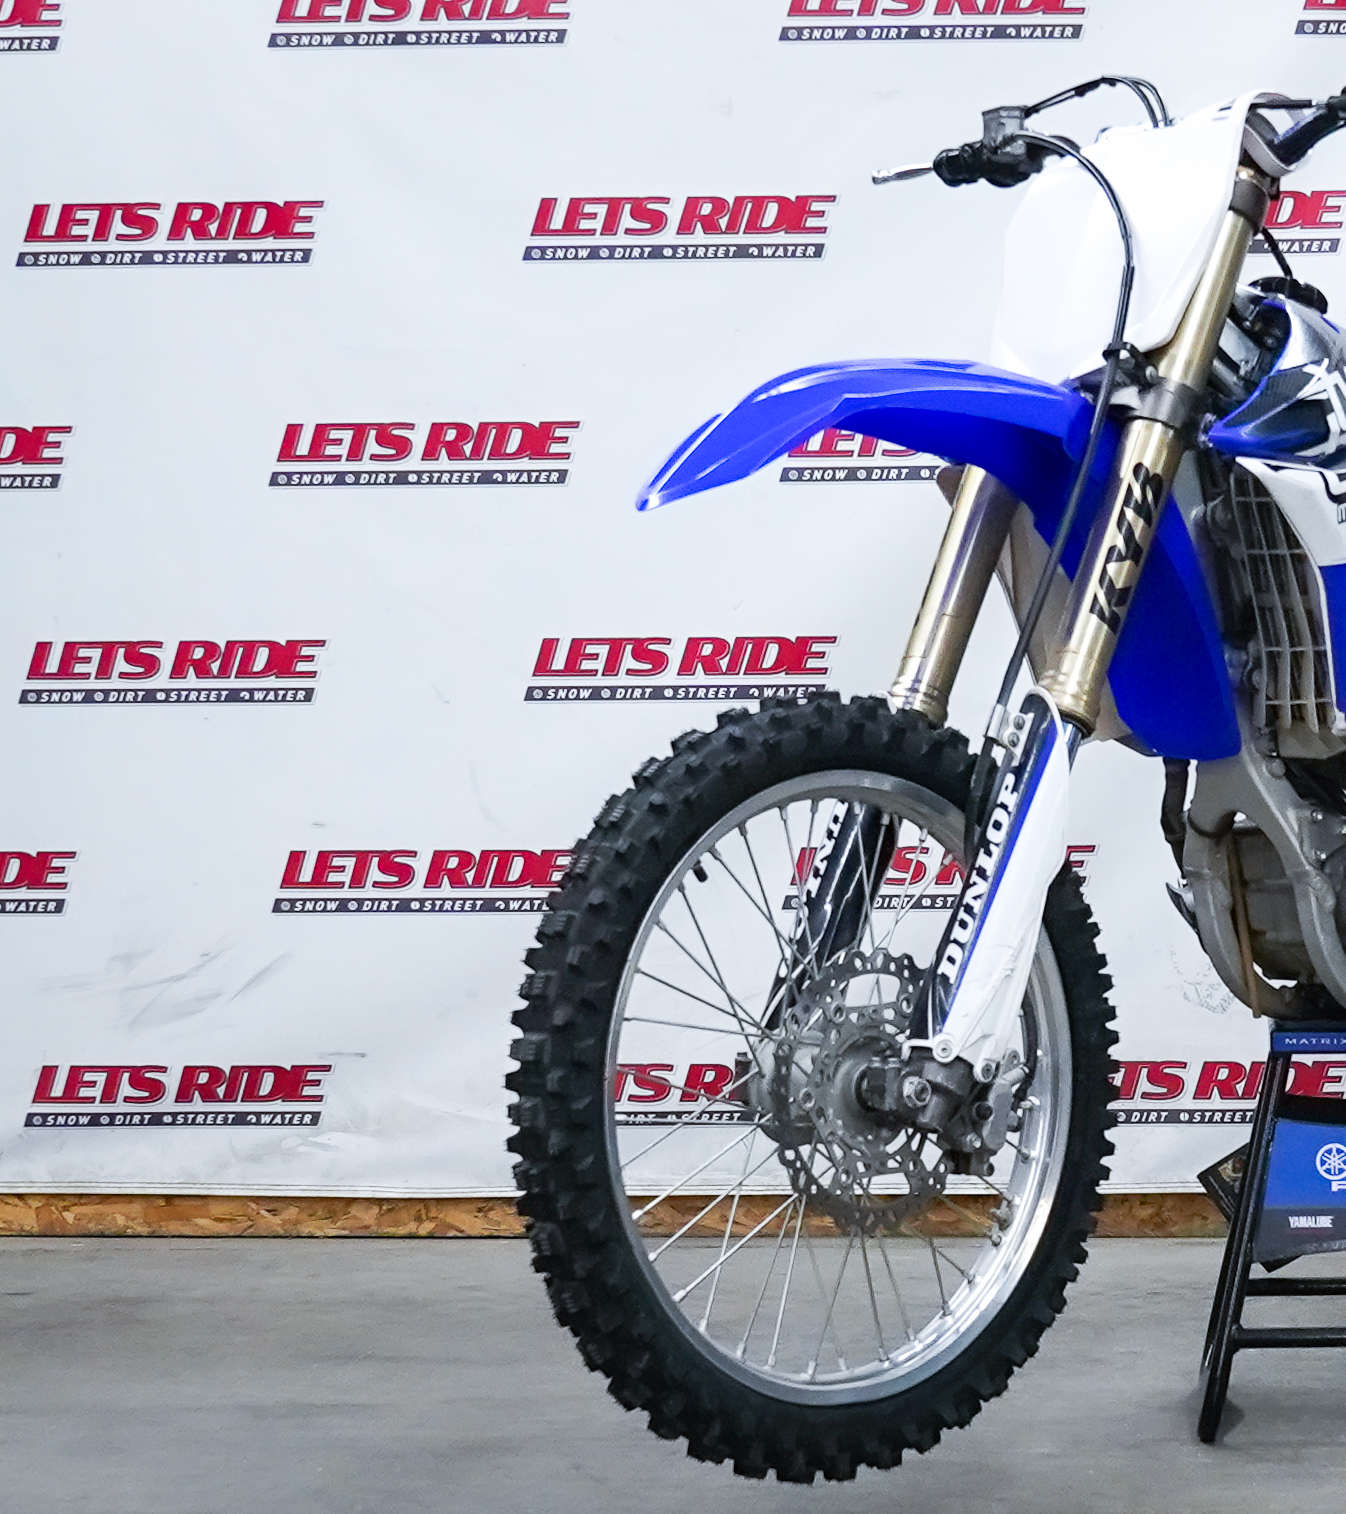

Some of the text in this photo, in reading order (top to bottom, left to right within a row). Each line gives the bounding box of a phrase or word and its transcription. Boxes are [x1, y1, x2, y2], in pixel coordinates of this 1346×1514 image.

[289, 30, 558, 46] SNOW DIRT STREET WATER
[801, 25, 1073, 39] SNOW DIRT STREET WATER
[0, 39, 50, 49] WATER
[531, 195, 834, 235] LETS RIDE
[23, 201, 323, 243] LETS RIDE
[545, 246, 816, 259] SNOW DIRT STREET WATER
[1278, 241, 1331, 251] WATER
[38, 251, 303, 264] SNOW DIRT STREET WATER
[276, 421, 580, 462] LETS RIDE
[291, 472, 559, 484] SNOW DIRT STREET WATER
[802, 469, 909, 480] SNOW DIRT
[0, 476, 52, 487] WATER
[1089, 462, 1164, 636] KYB
[25, 639, 327, 680] LETS RIDE
[531, 636, 838, 677] LETS RIDE
[40, 691, 306, 702] SNOW DIRT STREET WATER
[546, 689, 592, 699] SNOW
[616, 688, 653, 698] DIRT
[677, 687, 737, 698] STREET
[279, 849, 418, 889] LETS
[937, 772, 1018, 984] DUNLOP
[5, 901, 57, 912] WATER
[294, 901, 339, 911] SNOW
[362, 901, 399, 910] DIRT
[423, 900, 483, 911] STREET
[31, 1064, 333, 1104] LETS RIDE
[46, 1114, 312, 1125] SNOW DIRT STREET WATER
[1131, 1111, 1254, 1122] DIRT STREET
[1288, 1215, 1334, 1228] YAMALUBE
